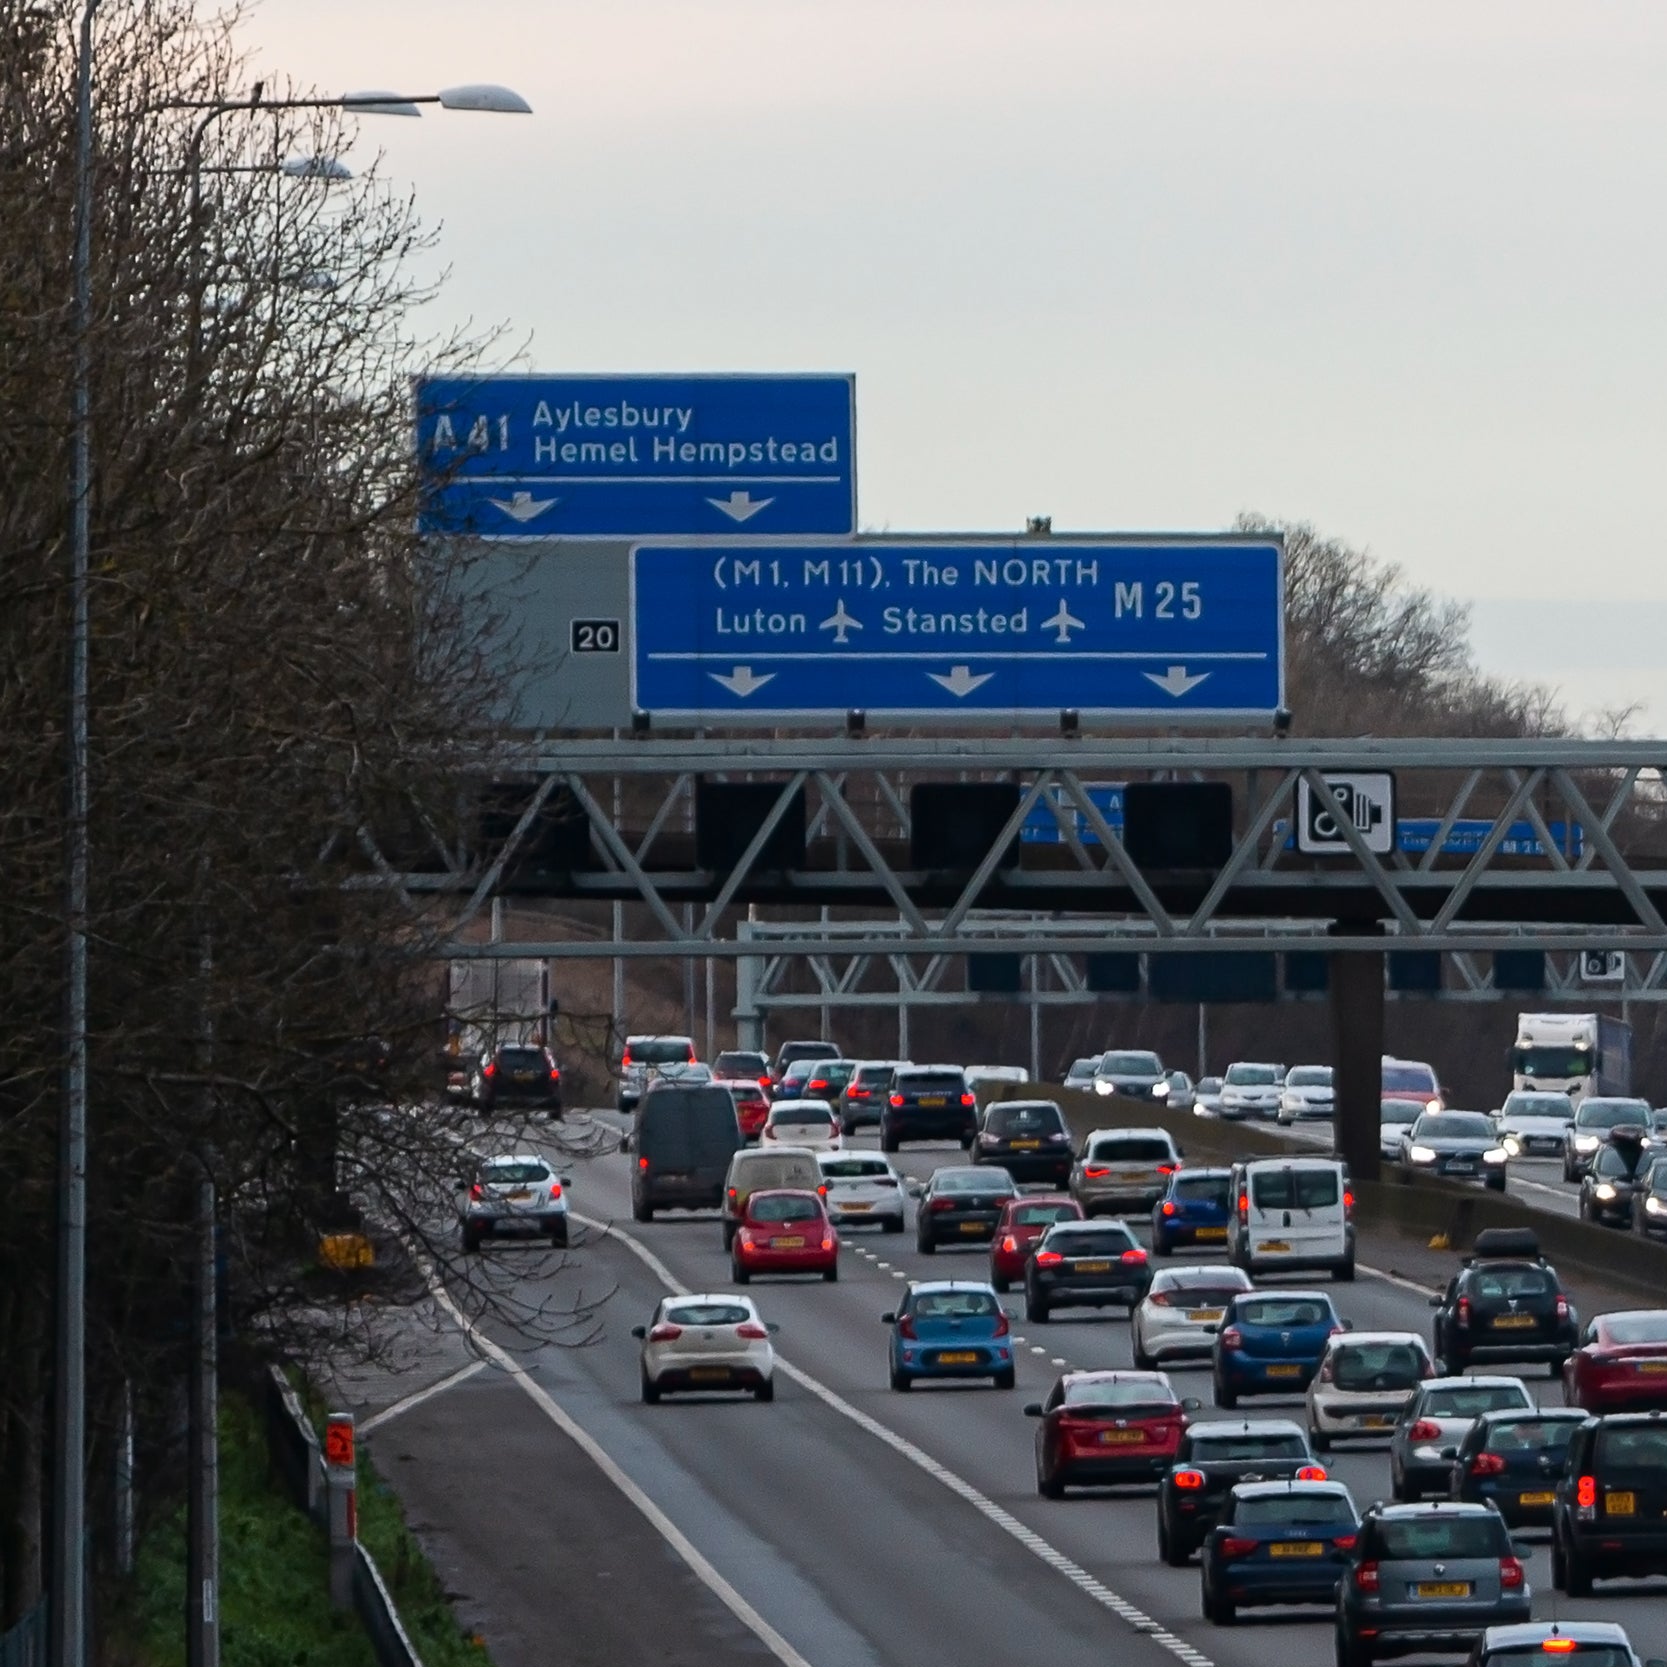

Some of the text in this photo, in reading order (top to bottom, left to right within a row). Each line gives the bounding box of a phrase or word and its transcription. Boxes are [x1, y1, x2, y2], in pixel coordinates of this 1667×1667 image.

[533, 400, 693, 433] Aylesbury
[534, 436, 838, 467] Hemel Hempstead
[903, 559, 959, 586] The
[973, 558, 1099, 586] NORTH
[716, 607, 1029, 635] Luton Stansted
[578, 624, 615, 650] 20
